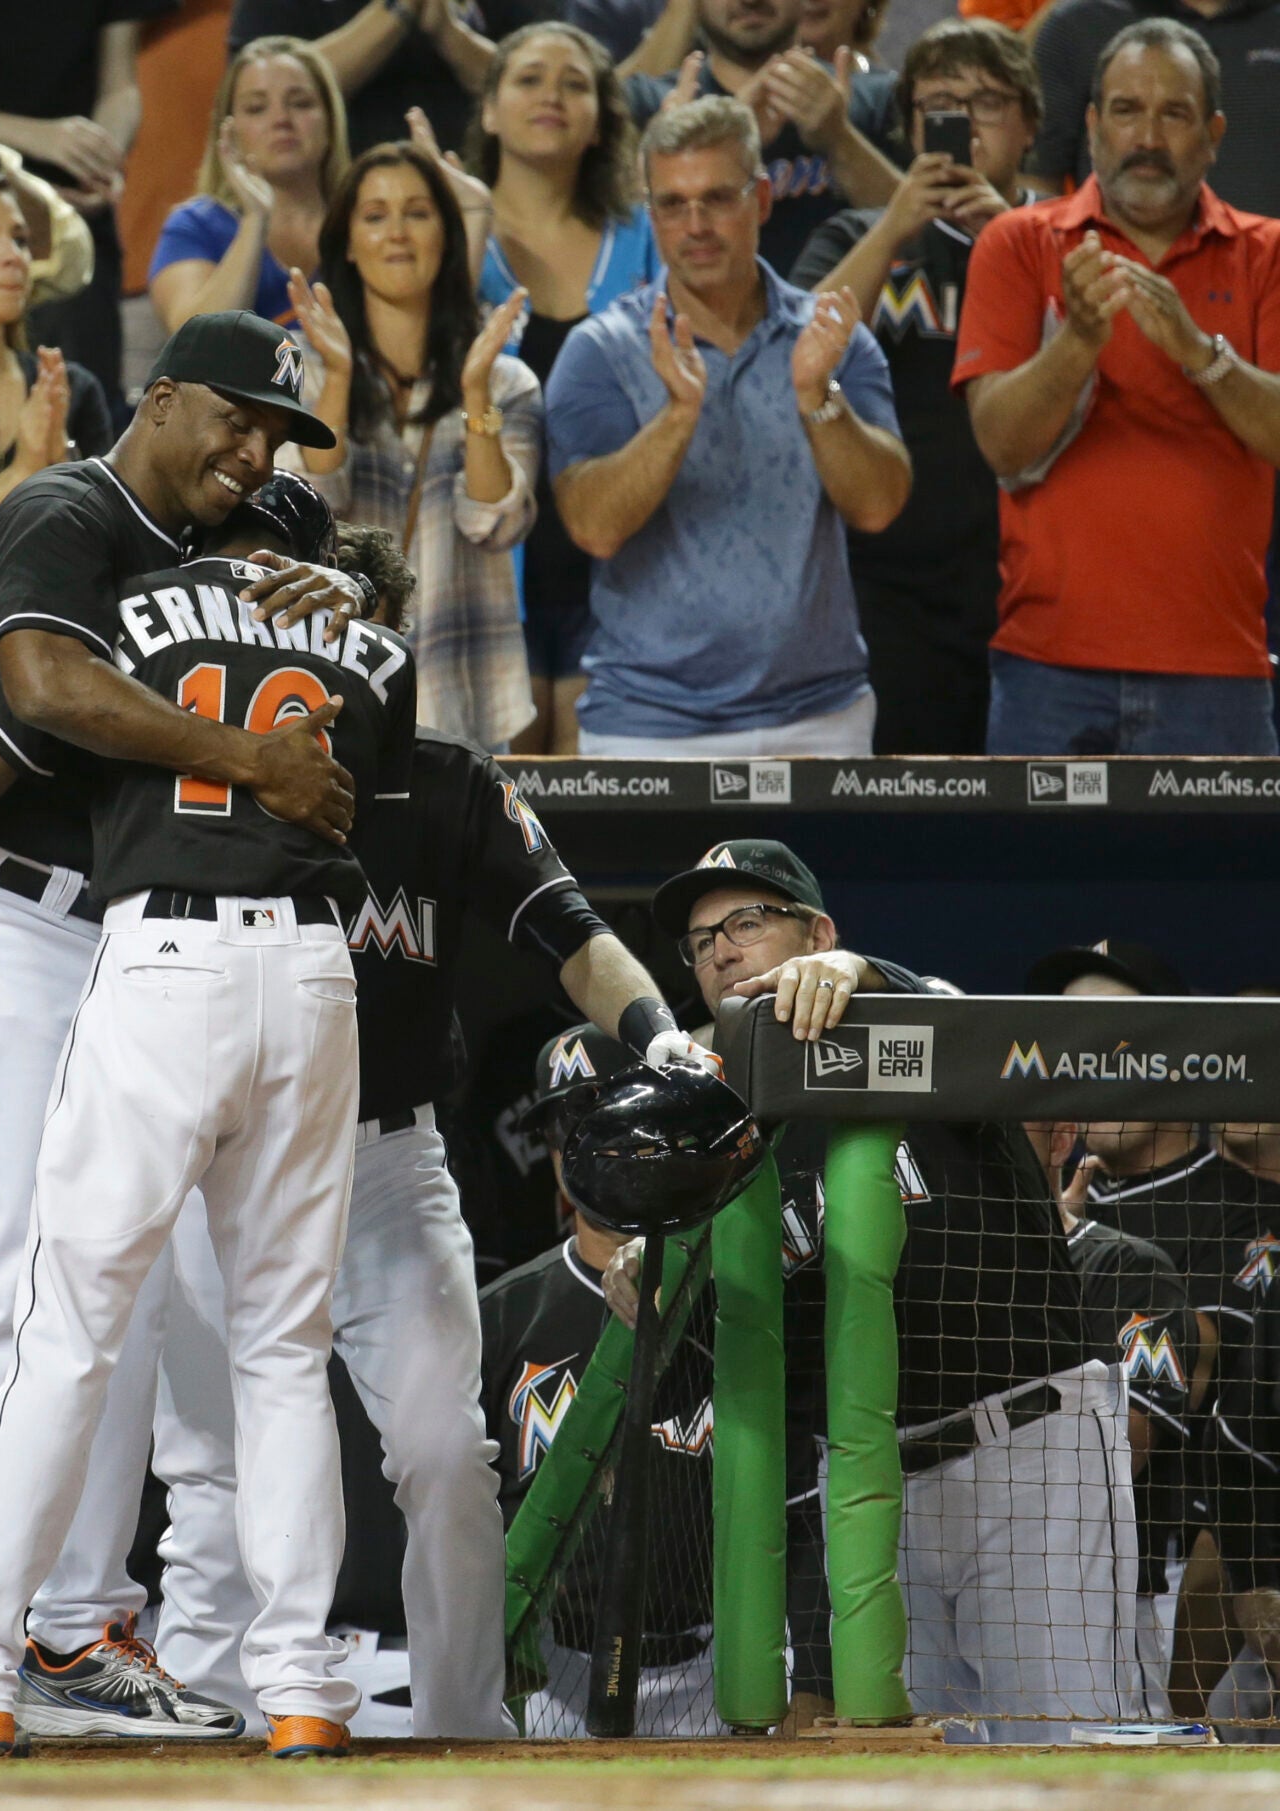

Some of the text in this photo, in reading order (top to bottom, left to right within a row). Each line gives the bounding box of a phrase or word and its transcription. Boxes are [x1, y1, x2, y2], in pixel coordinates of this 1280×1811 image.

[878, 1039, 924, 1059] NEW
[878, 1059, 923, 1077] ERA
[1000, 1040, 1249, 1083] MARLINS.COM
